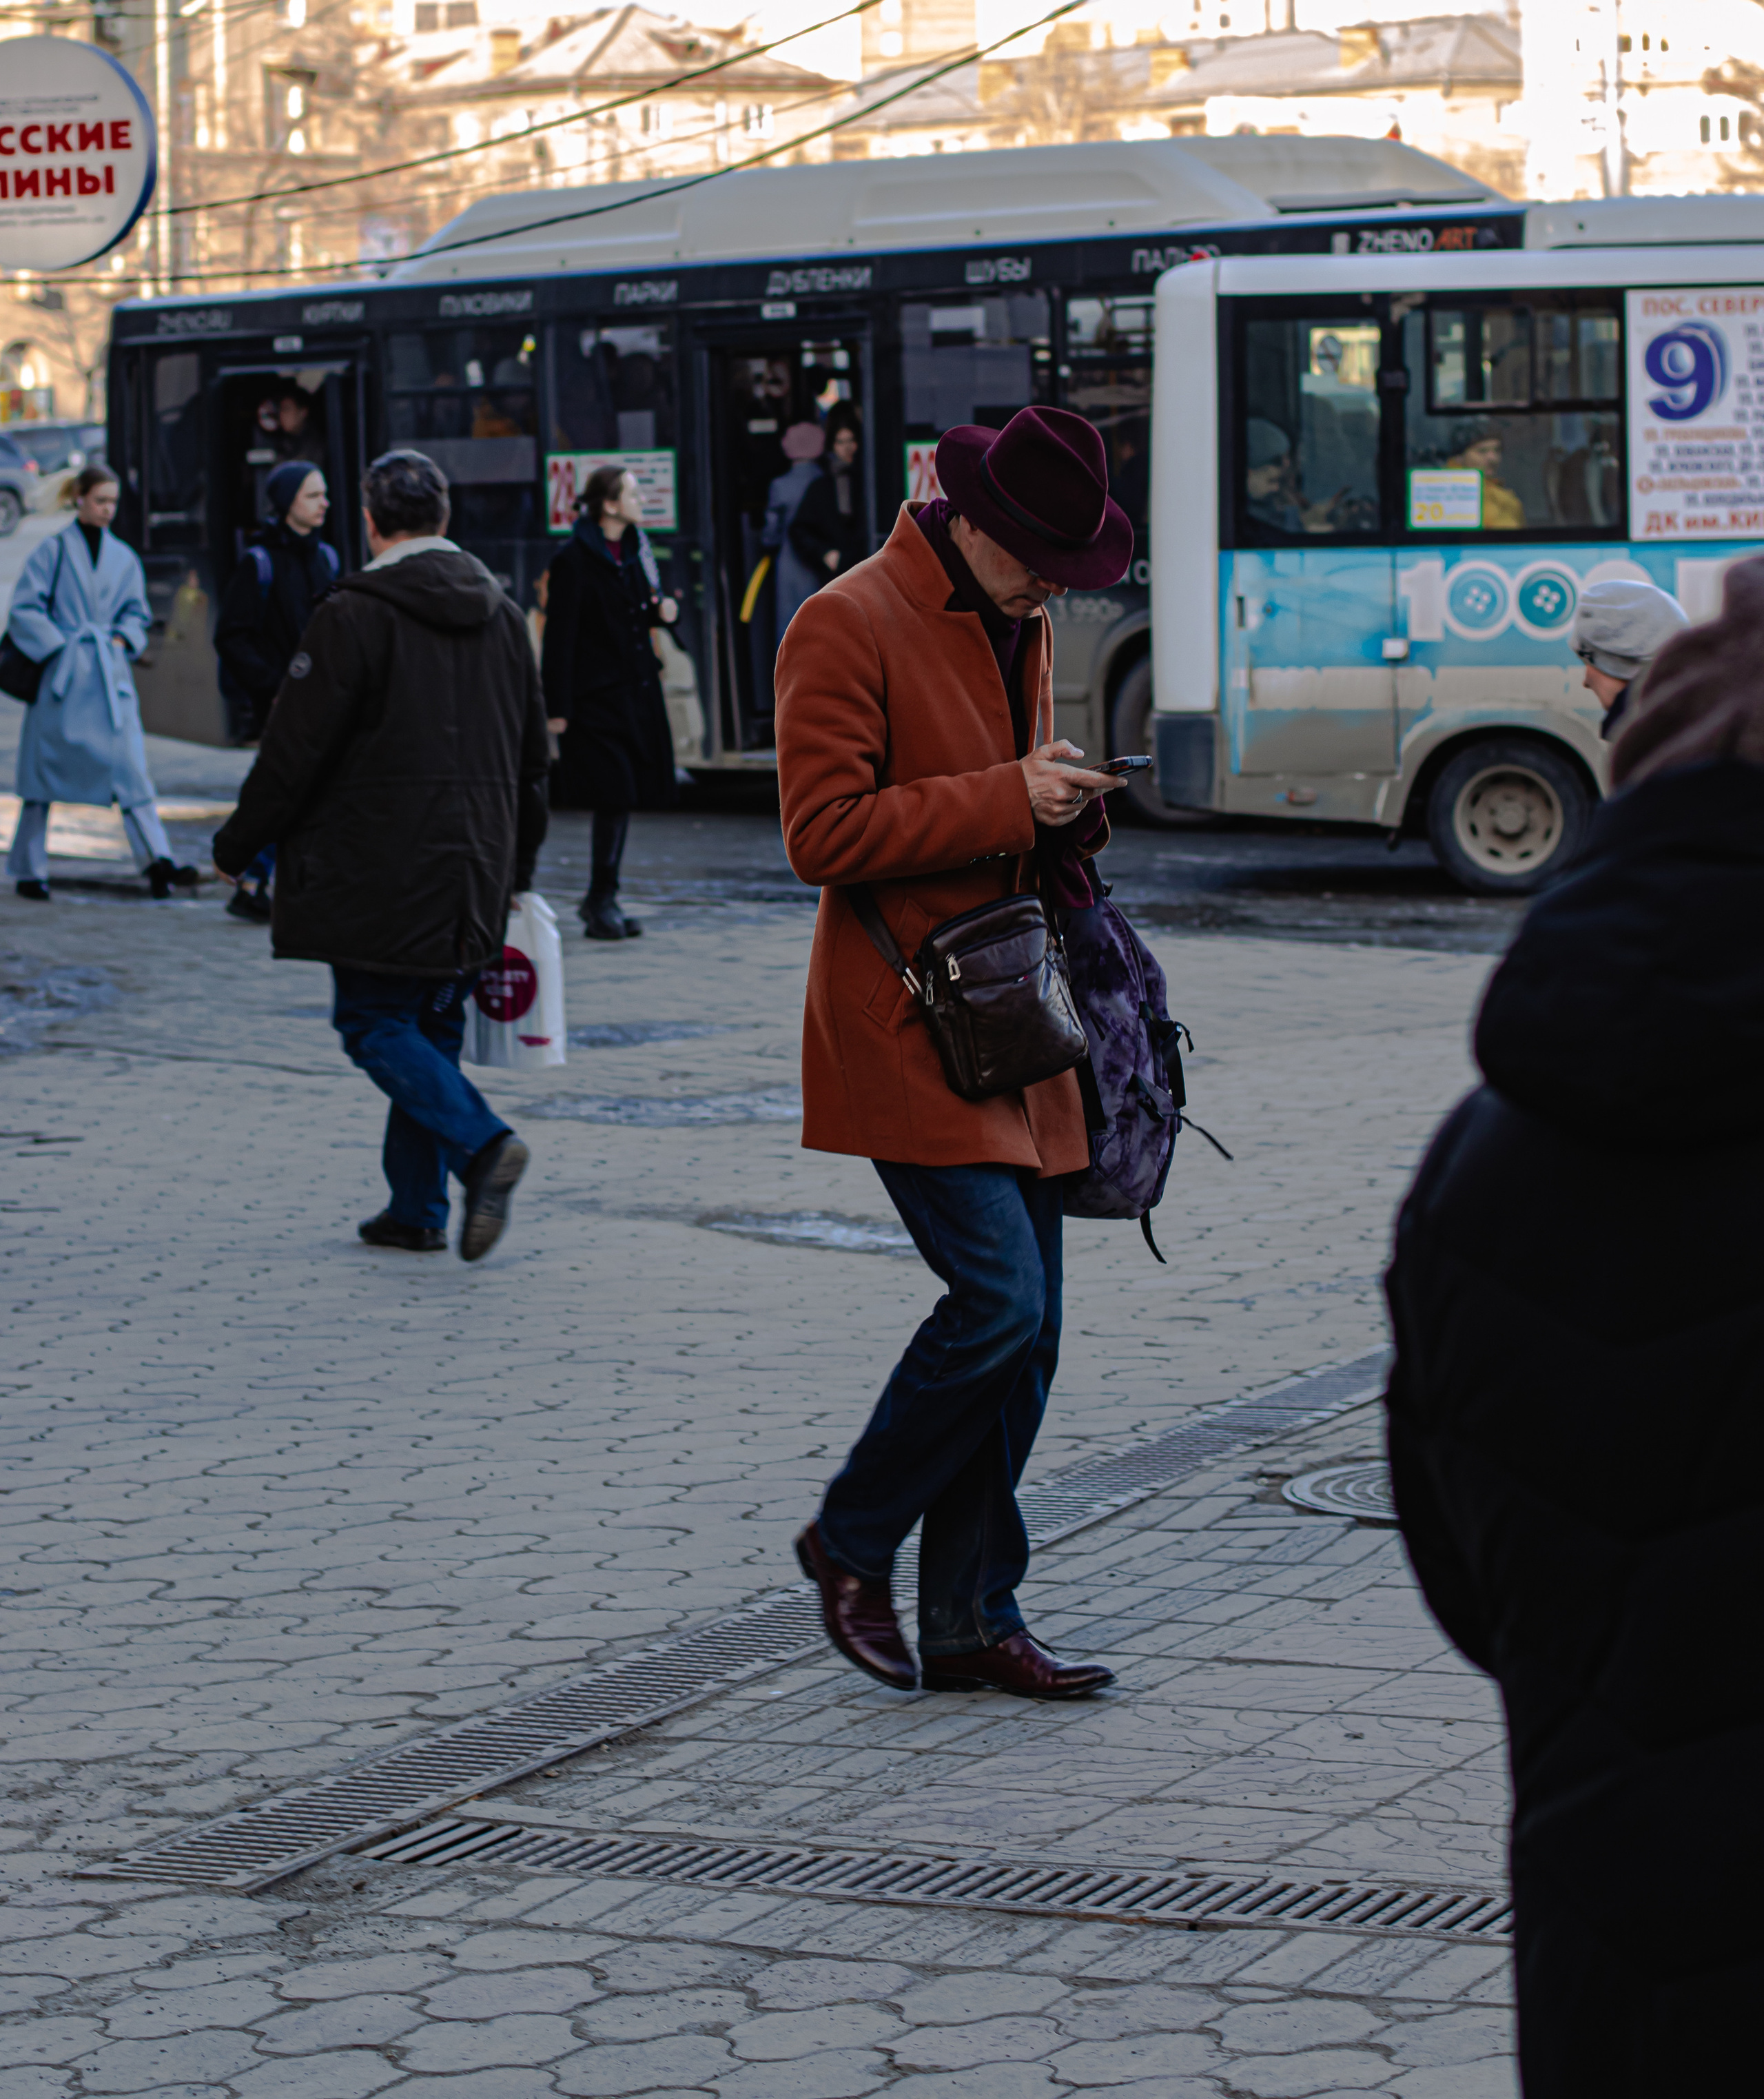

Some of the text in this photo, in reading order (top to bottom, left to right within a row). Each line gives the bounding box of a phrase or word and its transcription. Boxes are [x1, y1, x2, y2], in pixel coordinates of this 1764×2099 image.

[766, 267, 872, 296] ДУБЛЕНКИ
[965, 256, 1032, 285] ШУБЫ
[614, 280, 678, 305] ПАРКИ
[1644, 324, 1723, 420] 9
[1415, 502, 1444, 522] 20
[1400, 560, 1654, 642] 100
